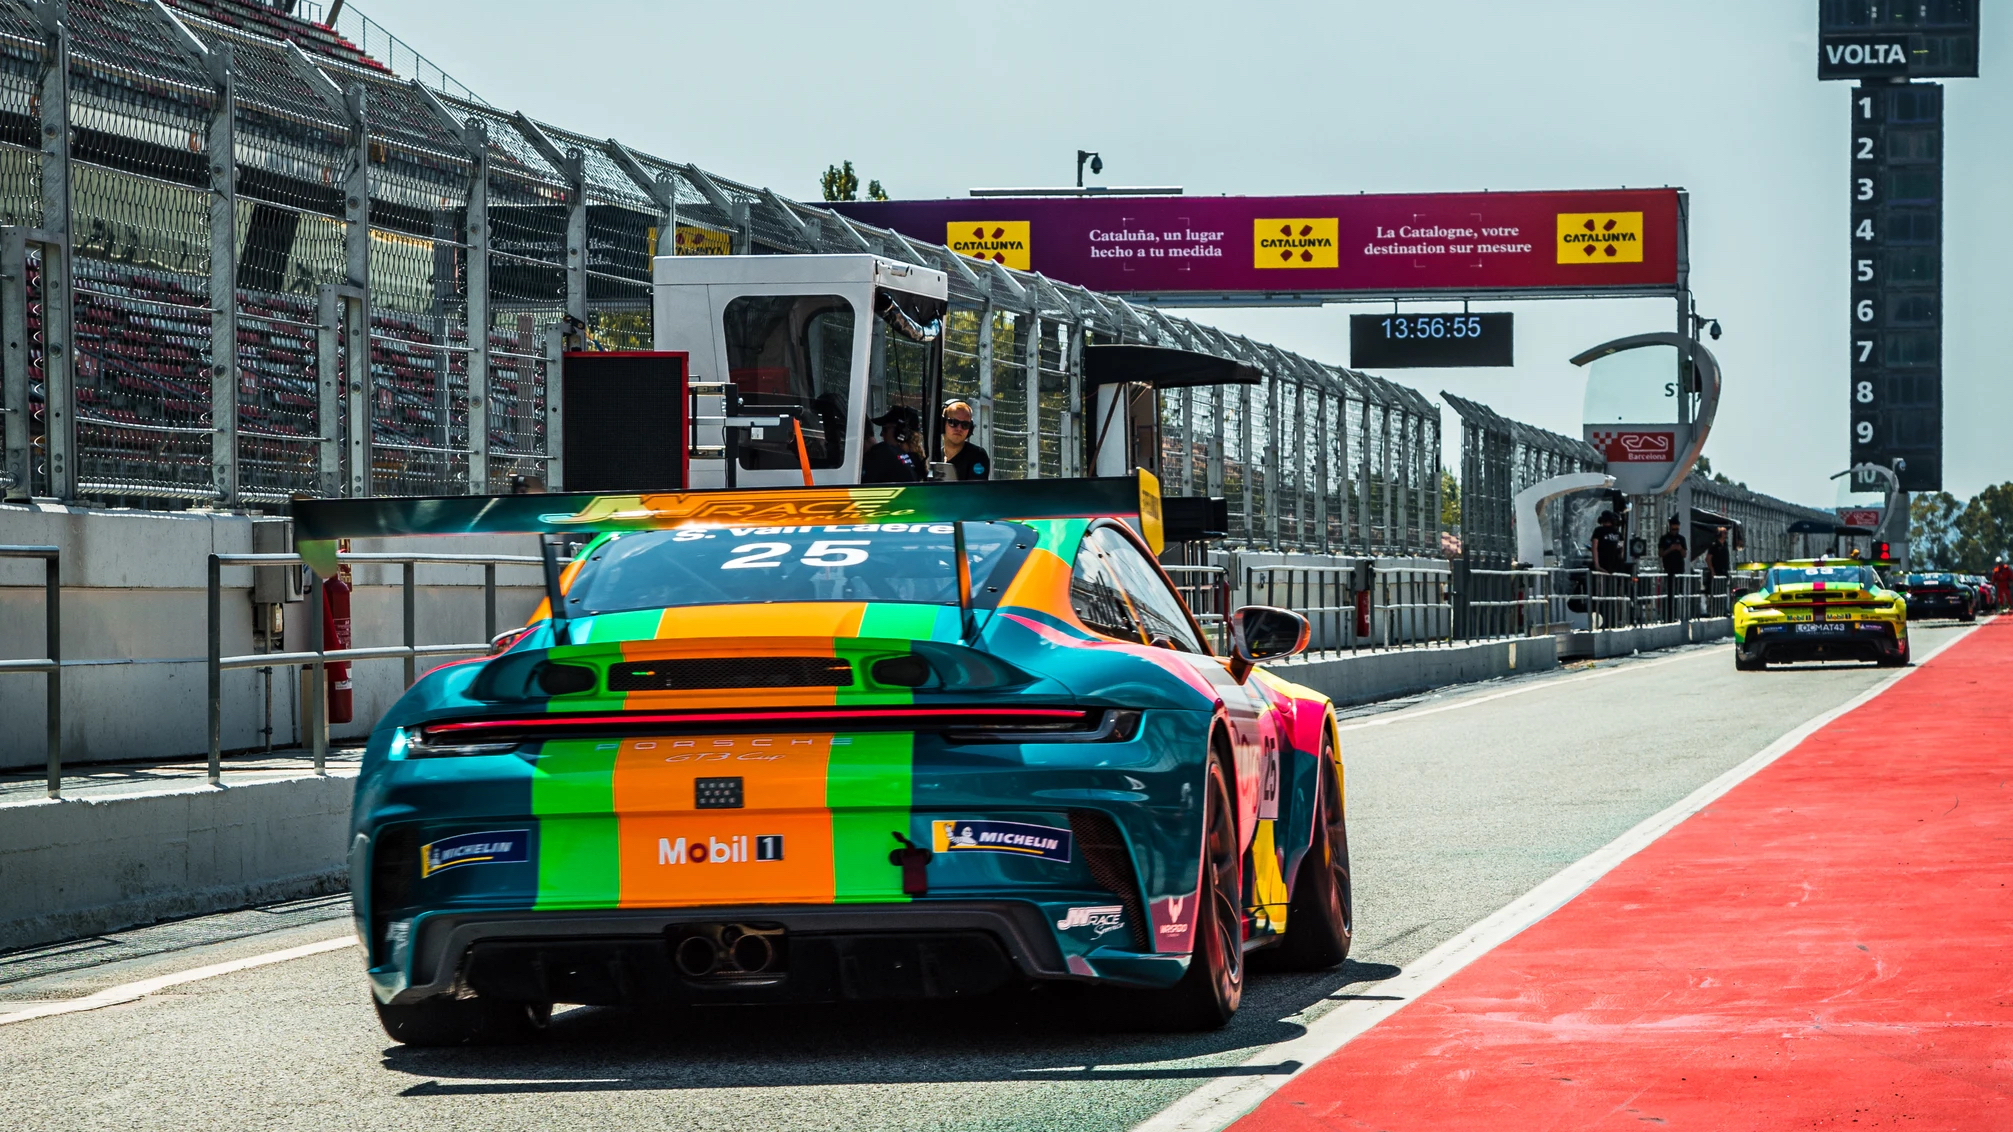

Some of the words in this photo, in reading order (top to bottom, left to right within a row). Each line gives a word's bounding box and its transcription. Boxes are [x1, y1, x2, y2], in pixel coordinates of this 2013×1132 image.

[1826, 44, 1906, 64] VOLTA
[1858, 97, 1871, 118] 1
[1857, 137, 1873, 159] 2
[1857, 178, 1873, 200] 3
[1089, 229, 1160, 243] Cataluña,
[1163, 231, 1181, 241] un
[1186, 229, 1224, 243] lugar
[1376, 226, 1395, 239] La
[1399, 225, 1478, 240] Catalogne,
[1481, 226, 1519, 237] votre
[1563, 232, 1636, 243] CATALUNYA
[1855, 219, 1874, 240] 4
[953, 241, 1023, 250] CATALUNYA
[1090, 246, 1133, 257] hecho
[1137, 248, 1146, 257] a
[1149, 247, 1164, 257] tu
[1168, 245, 1222, 257] medida
[1260, 238, 1332, 248] CATALUNYA
[1364, 242, 1445, 255] destination
[1449, 243, 1473, 254] sur
[1477, 243, 1532, 253] mesure
[1857, 259, 1874, 281] 5
[1856, 299, 1874, 322] 6
[1381, 317, 1481, 339] 13:56:55
[1857, 341, 1873, 363] 7
[1856, 381, 1874, 403] 8
[1856, 421, 1873, 443] 9
[1855, 462, 1876, 484] 10
[721, 540, 871, 569] 25
[594, 737, 853, 751] PORSCHE
[665, 752, 731, 763] GT3
[736, 751, 786, 763] Cup
[440, 841, 513, 860] MICHELIN
[658, 835, 748, 865] Mobil
[979, 832, 1058, 850] MICHELIN
